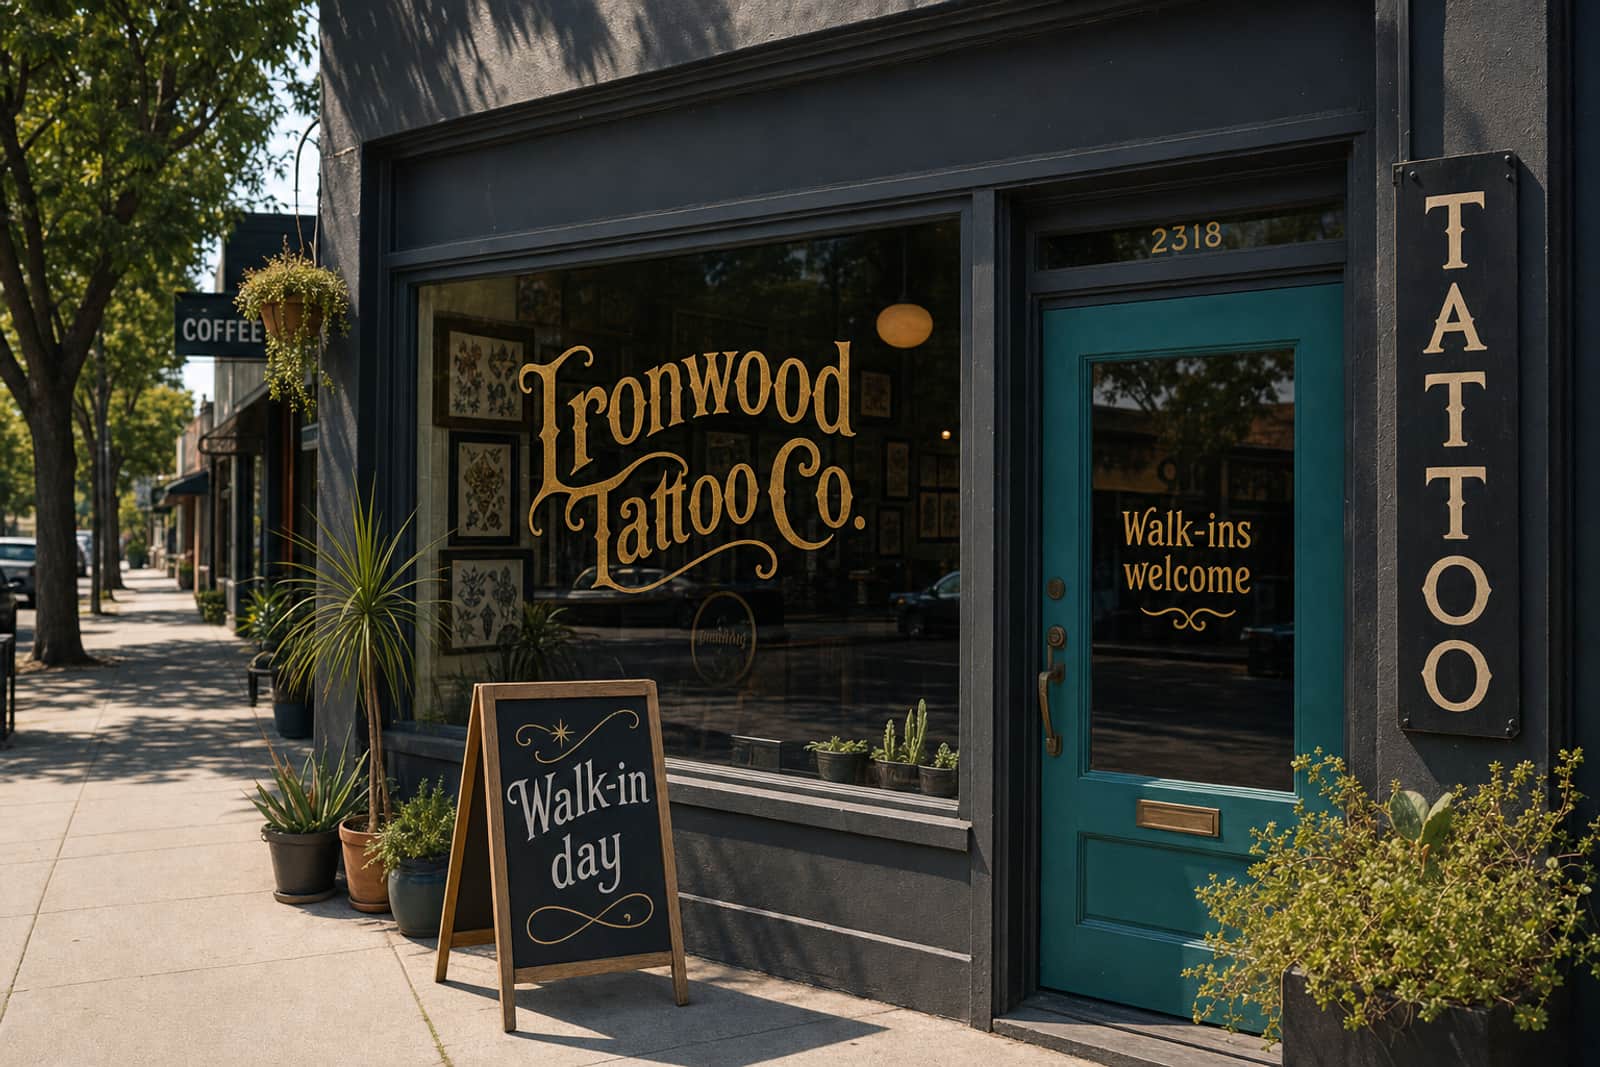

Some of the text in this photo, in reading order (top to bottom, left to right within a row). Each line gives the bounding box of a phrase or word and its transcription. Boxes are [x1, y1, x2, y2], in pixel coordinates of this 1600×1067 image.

[1151, 221, 1223, 254] 2318
[183, 318, 262, 343] COFFEE
[518, 341, 857, 537] Ironwood
[1421, 190, 1492, 712] TATTOO
[565, 437, 866, 594] Tattoo Co.
[1123, 507, 1251, 549] Walk-ins
[1123, 555, 1251, 594] welcome
[507, 758, 650, 841] Walk-in
[551, 833, 621, 894] day
